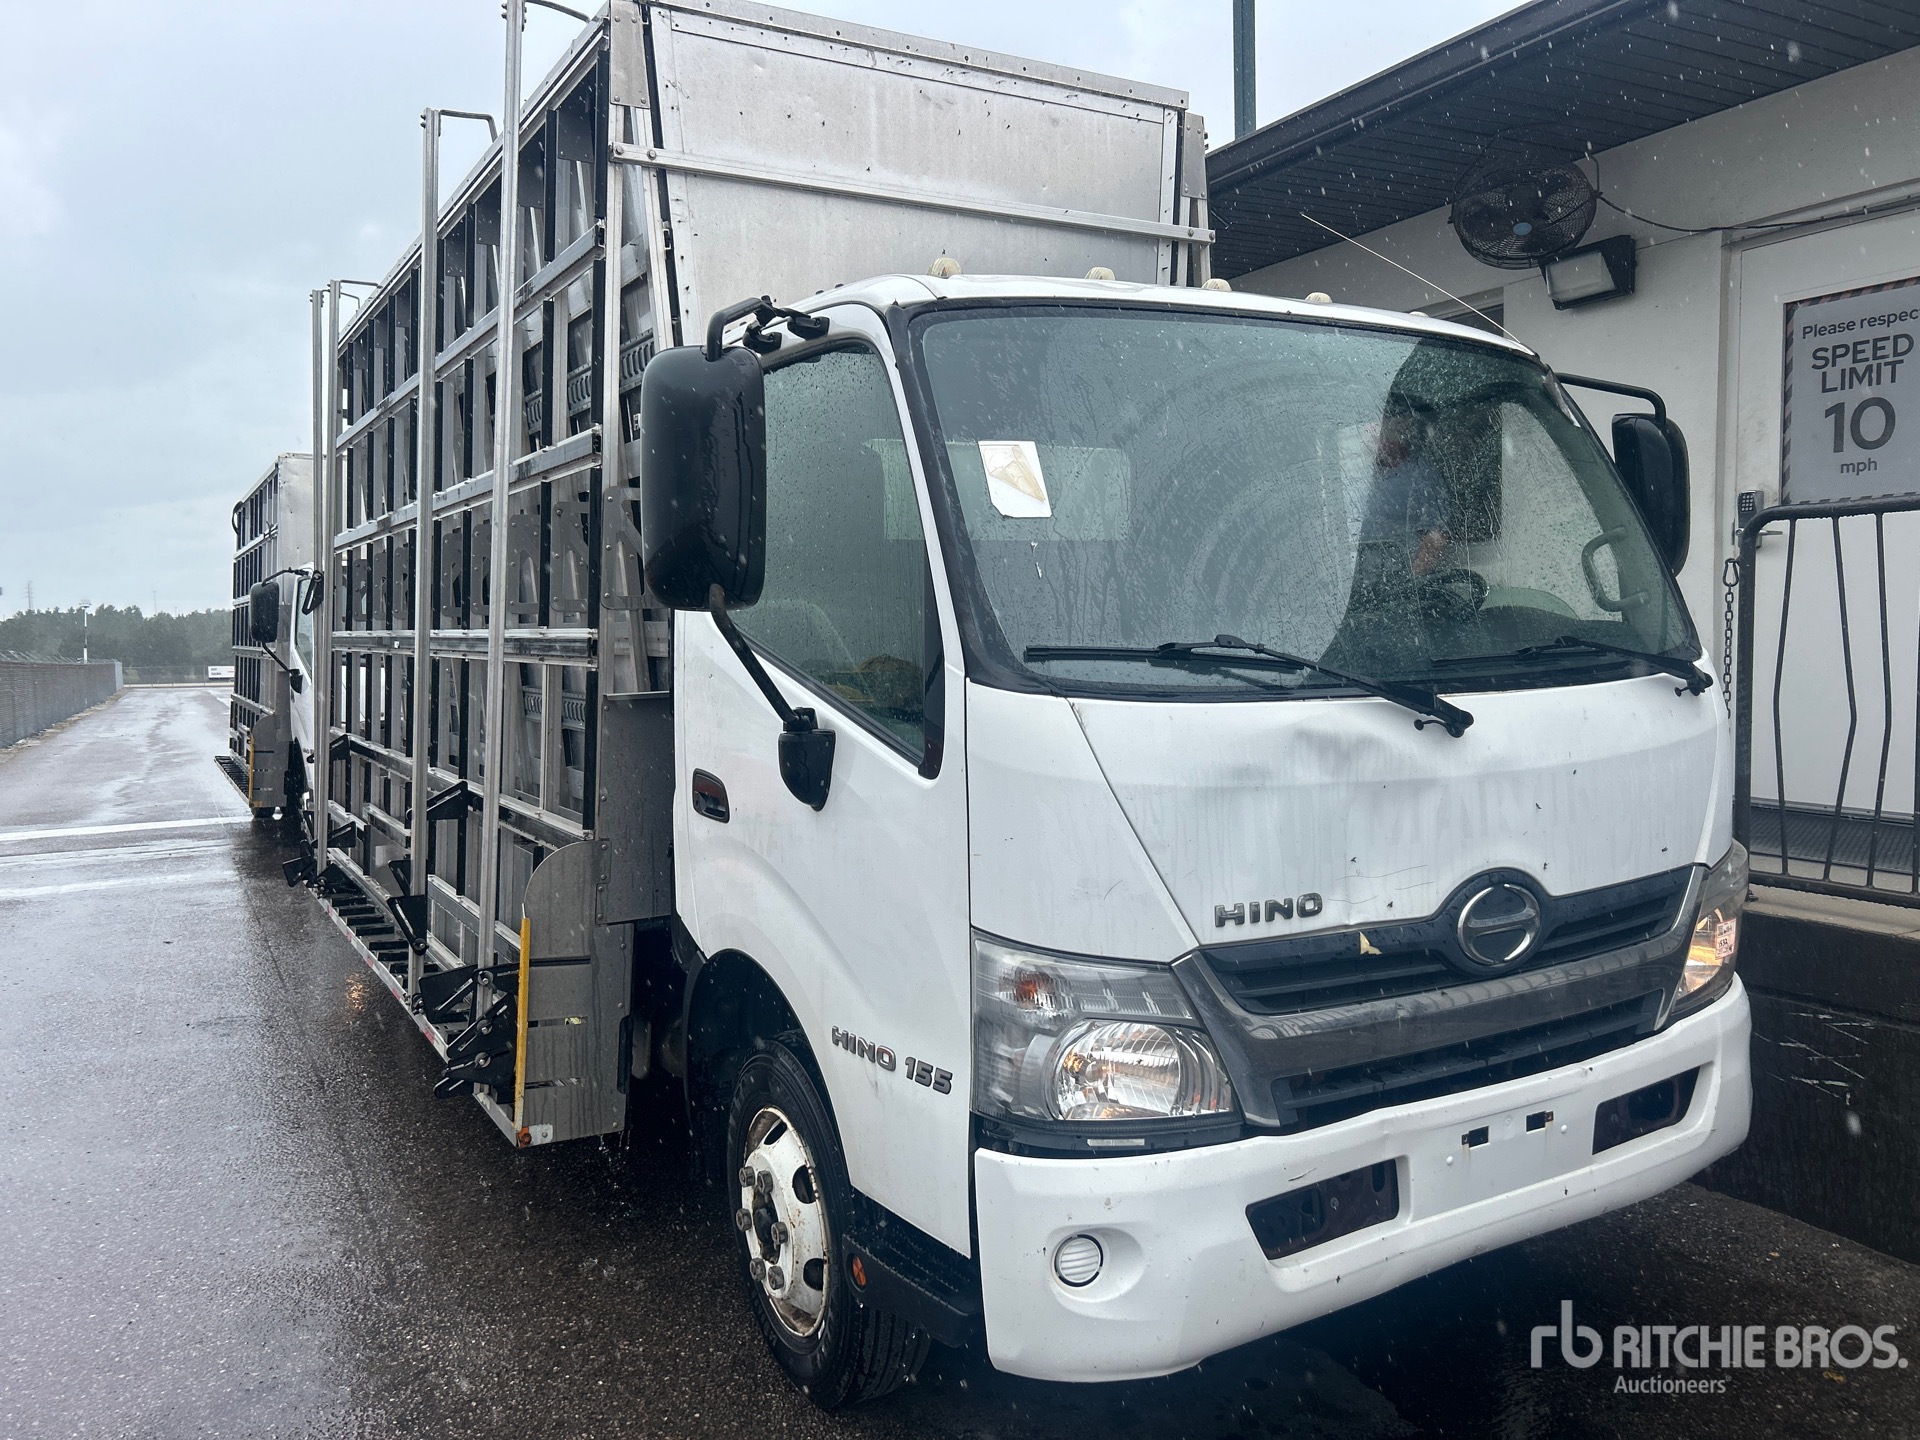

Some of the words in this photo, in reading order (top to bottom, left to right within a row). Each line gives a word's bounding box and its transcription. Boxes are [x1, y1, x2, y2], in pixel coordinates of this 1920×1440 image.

[1803, 320, 1856, 340] Please
[1860, 308, 1920, 328] respec
[1811, 333, 1914, 370] SPEED
[1821, 359, 1904, 393] LIMIT
[1825, 397, 1895, 453] 10
[1840, 458, 1878, 475] mph
[1214, 892, 1323, 928] HINO
[831, 1025, 896, 1071] HINO
[905, 1056, 954, 1095] 155
